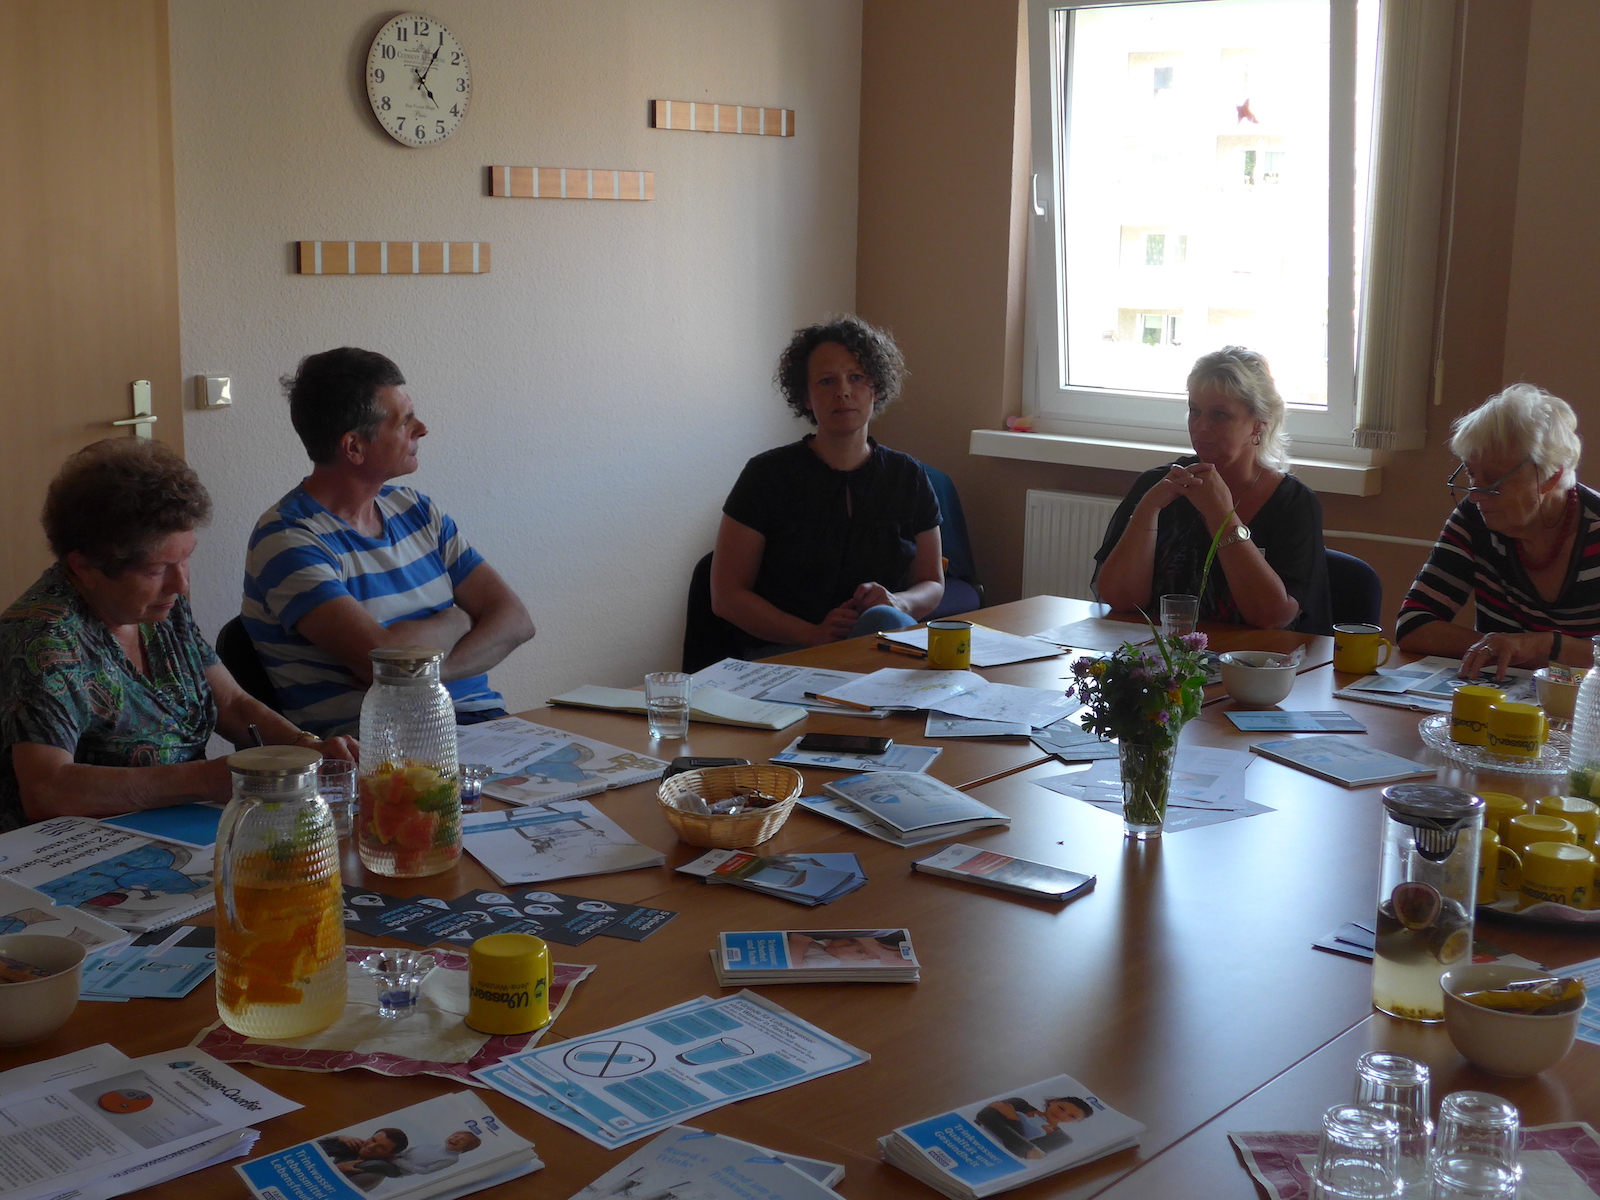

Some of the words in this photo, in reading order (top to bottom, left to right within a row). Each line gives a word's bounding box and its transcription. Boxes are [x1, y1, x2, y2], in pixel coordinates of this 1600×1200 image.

[397, 27, 408, 42] 11
[413, 21, 429, 36] 12
[439, 32, 444, 46] 1
[381, 45, 396, 60] 10
[450, 51, 460, 66] 2
[374, 68, 385, 83] 9
[455, 78, 466, 92] 3
[381, 96, 391, 111] 8
[449, 103, 459, 117] 4
[396, 117, 406, 131] 7
[435, 120, 445, 134] 5
[415, 125, 426, 139] 6
[934, 1131, 980, 1168] Gesundheit
[944, 1127, 978, 1155] Qualität
[975, 1154, 996, 1167] und
[954, 1124, 1003, 1164] Trinkwasser:
[296, 1149, 337, 1194] Trinkwasser:
